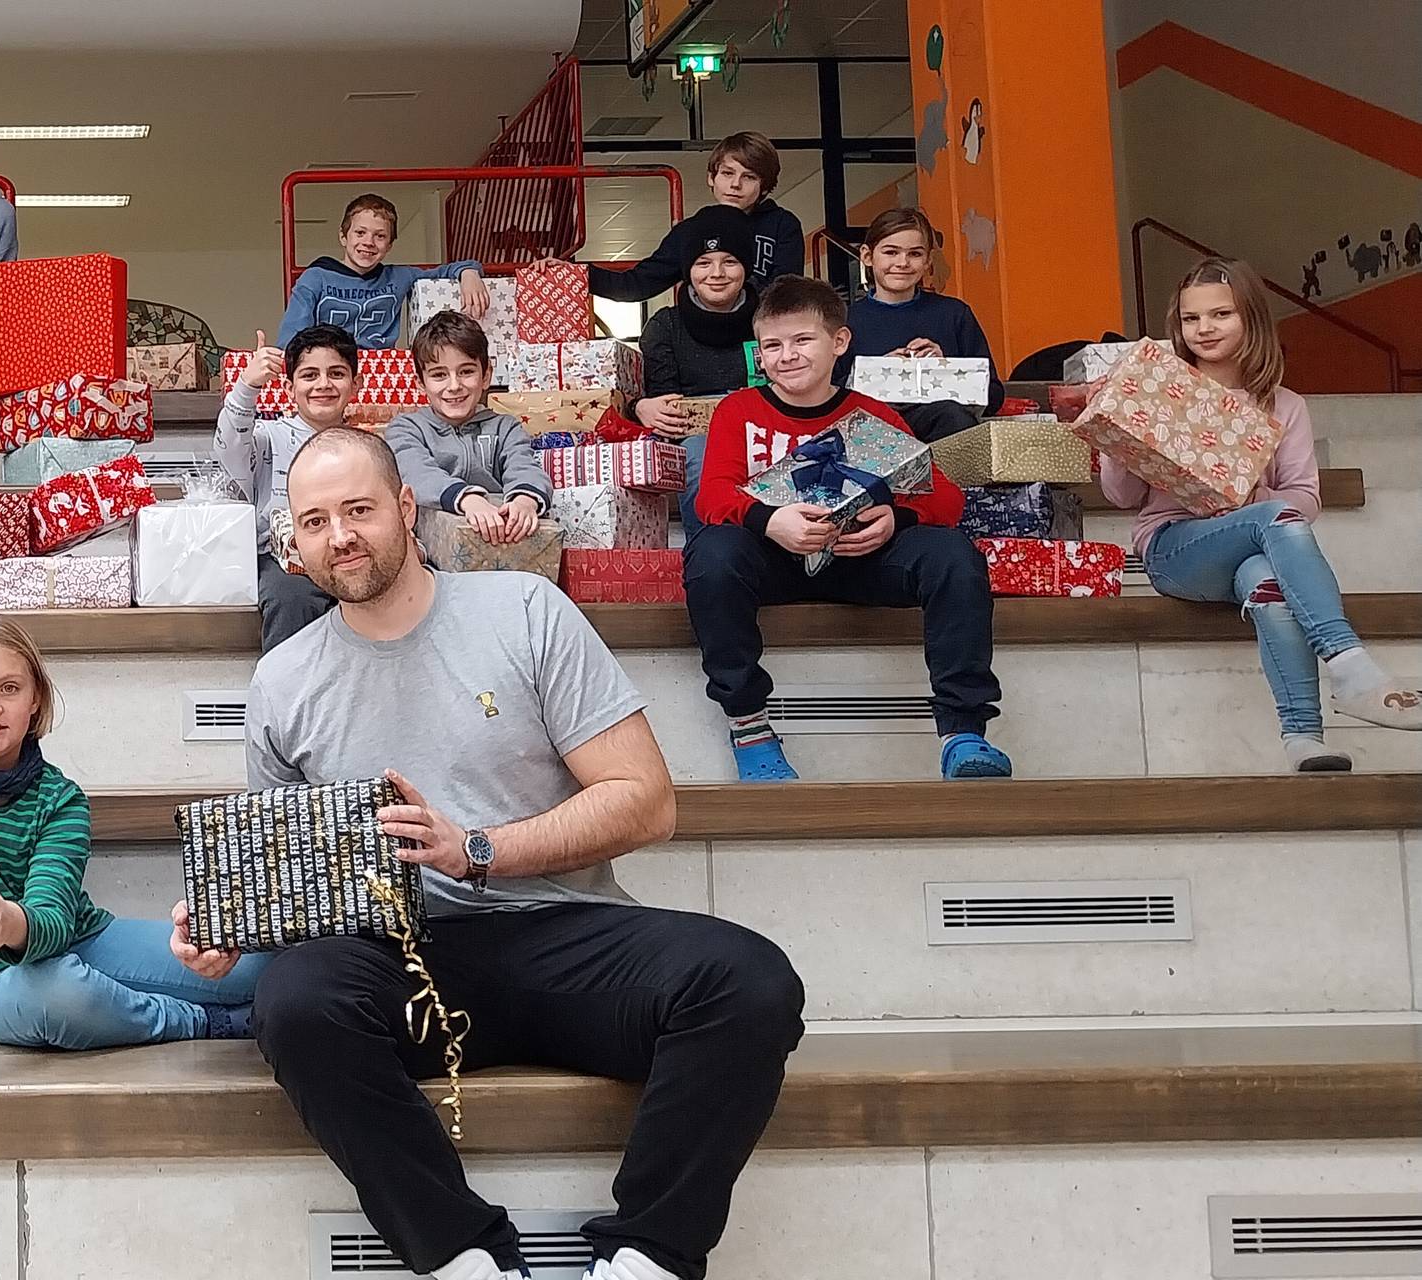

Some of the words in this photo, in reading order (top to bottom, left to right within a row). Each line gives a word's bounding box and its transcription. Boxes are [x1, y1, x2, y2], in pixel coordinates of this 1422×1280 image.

[213, 806, 224, 823] GOD
[334, 789, 347, 822] FROHES
[216, 839, 228, 874] NAVIDAD
[228, 837, 240, 871] FROHES
[288, 831, 299, 854] FEST
[300, 831, 313, 880] NATALE
[338, 834, 351, 869] BUON
[183, 843, 193, 877] BUON
[253, 855, 266, 895] FROHES
[279, 859, 291, 894] NAVIDAD
[290, 857, 303, 892] FROHES
[314, 850, 326, 873] FEST
[352, 852, 364, 874] FEST
[219, 876, 230, 897] FELIZ
[231, 871, 241, 887] JUL
[242, 862, 254, 897] BUON
[316, 874, 330, 916] FROHES
[355, 876, 368, 912] FROHES
[207, 882, 221, 944] WEIHNACHTEN
[232, 889, 243, 907] GOD
[281, 895, 293, 918] FELIZ
[293, 892, 304, 907] JUL
[305, 882, 318, 918] BUON
[329, 887, 346, 923] Joyaux
[342, 879, 355, 915] NAVIDAD
[295, 909, 306, 928] GOD
